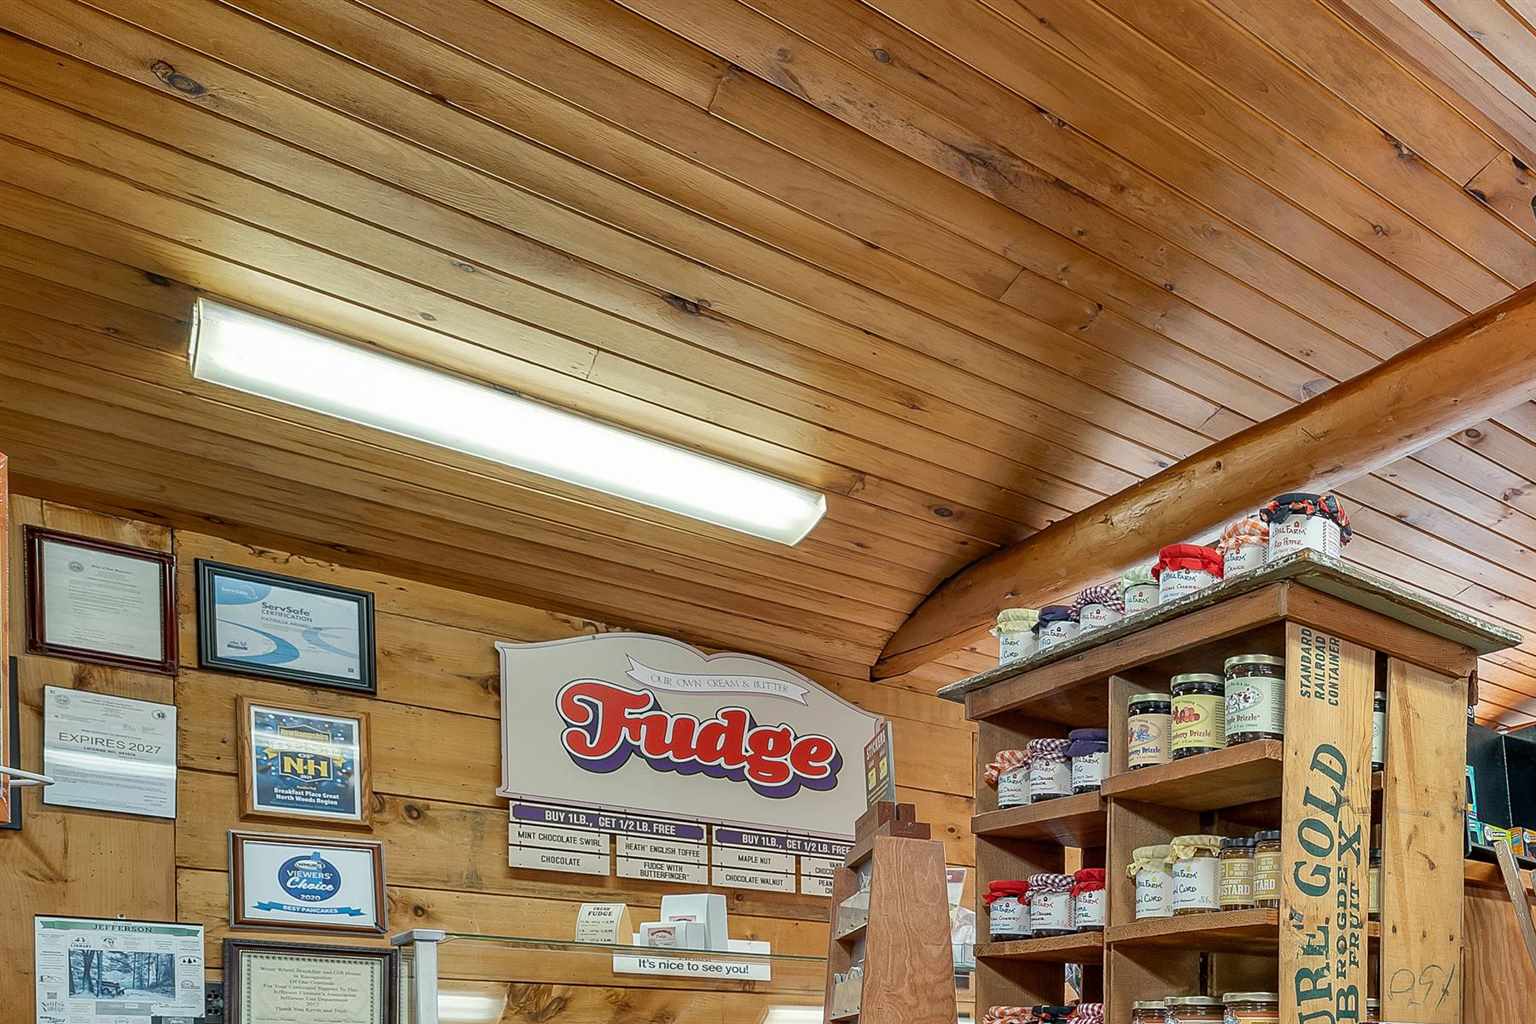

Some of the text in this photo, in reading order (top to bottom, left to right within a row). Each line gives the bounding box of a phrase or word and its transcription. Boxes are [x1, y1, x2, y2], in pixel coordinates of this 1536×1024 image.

[261, 602, 311, 617] ServSafe
[261, 609, 313, 623] CERTIFICATION
[1300, 628, 1313, 698] STANDARD
[1314, 635, 1326, 700] RAILROAD
[1328, 637, 1340, 706] CONTAINER
[677, 678, 702, 688] OWN
[706, 679, 740, 688] CREAM
[556, 679, 842, 797] Fudge
[1190, 730, 1211, 738] Drizzle
[58, 732, 126, 750] EXPIRES
[128, 742, 161, 755] 2027
[274, 787, 305, 796] Breakfast
[305, 790, 322, 798] Place
[544, 809, 566, 823] BUY
[598, 817, 618, 829] GET
[620, 819, 635, 832] 1/2
[636, 821, 651, 833] LB.
[653, 823, 676, 836] FREE
[1293, 742, 1349, 898] GOLD
[517, 831, 603, 847] MINT CHOCOLATE SWIRL
[742, 833, 759, 845] BUY
[786, 839, 801, 849] GET
[803, 841, 817, 851] 1/2
[818, 843, 831, 853] LB.
[649, 844, 701, 858] ENGLISH TOFFEE
[540, 854, 581, 867] CHOCOLATE
[643, 862, 683, 873] FUDGE WITH
[737, 855, 771, 866] MAPLE NUT
[286, 877, 335, 892] Choice
[725, 874, 784, 887] CHOCOLATE WALNUT
[301, 906, 339, 914] PANCAKES
[92, 923, 152, 933] JEFFERSON
[638, 958, 749, 977] It's nice to see you!
